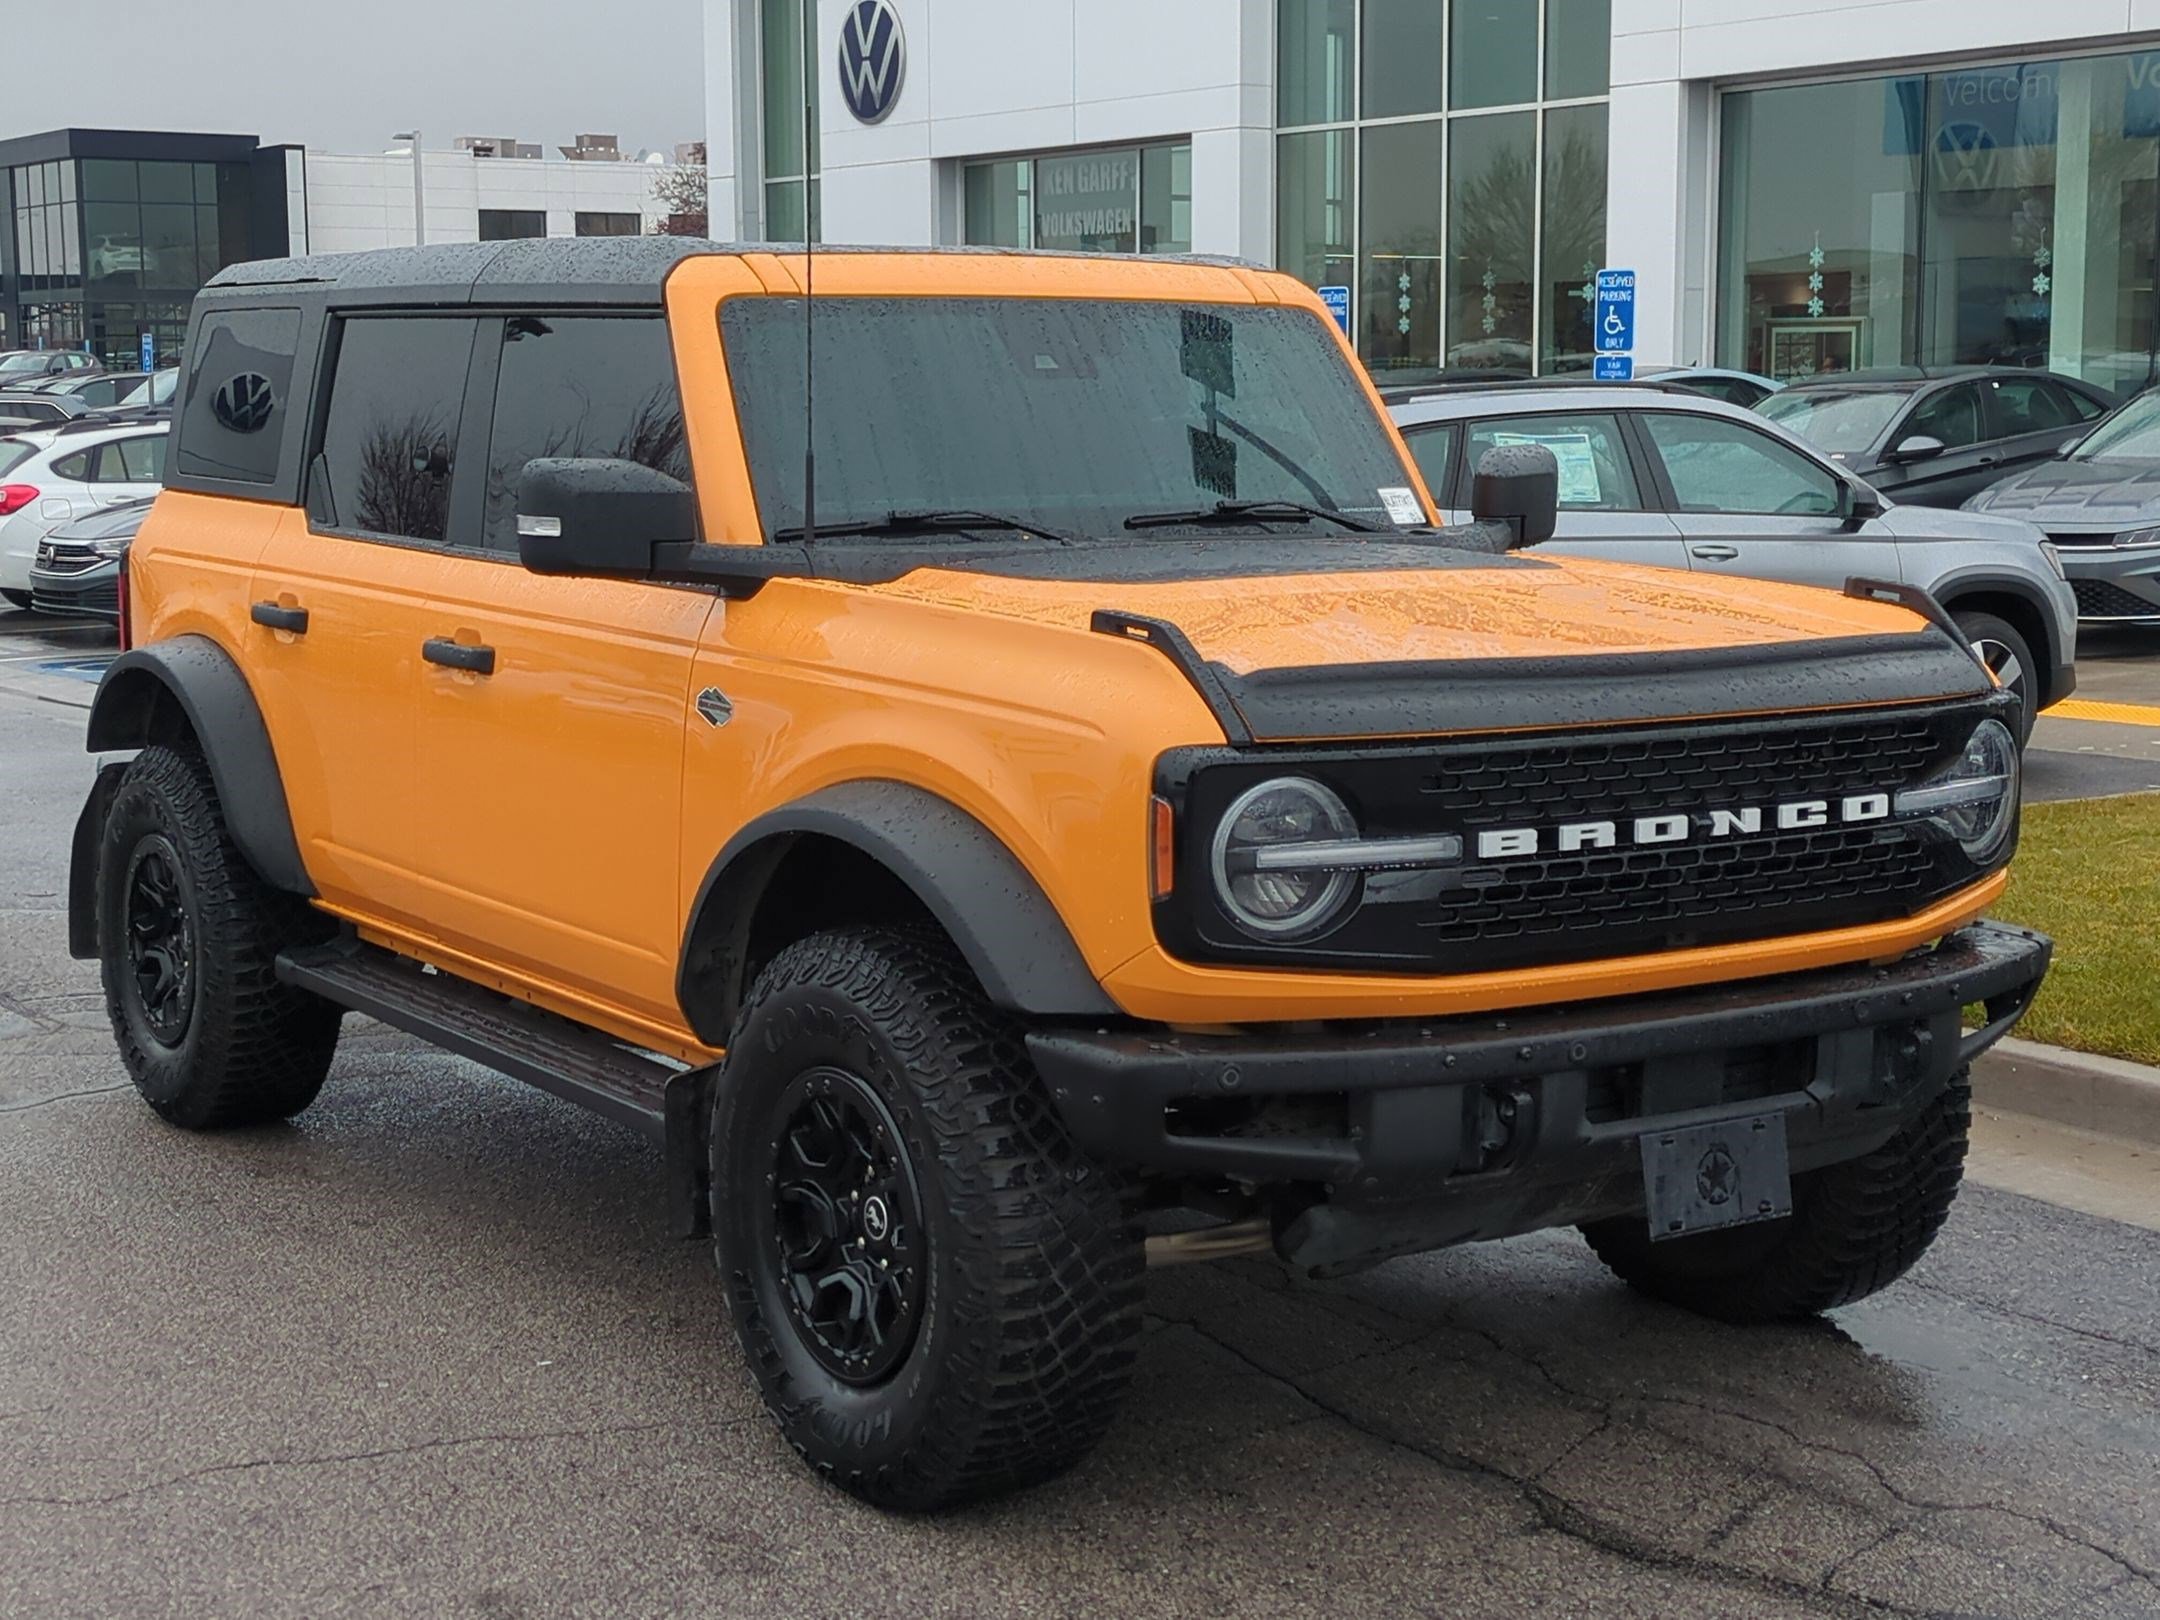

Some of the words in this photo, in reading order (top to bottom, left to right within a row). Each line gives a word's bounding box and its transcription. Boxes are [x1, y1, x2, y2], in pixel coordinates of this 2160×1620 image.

[1044, 164, 1074, 196] KEN
[1040, 208, 1131, 238] VOLKSWAGEN
[1599, 275, 1634, 288] RESERVED
[1600, 290, 1632, 302] PARKING
[1604, 337, 1624, 349] ONLY
[1478, 793, 1889, 858] BRONCO
